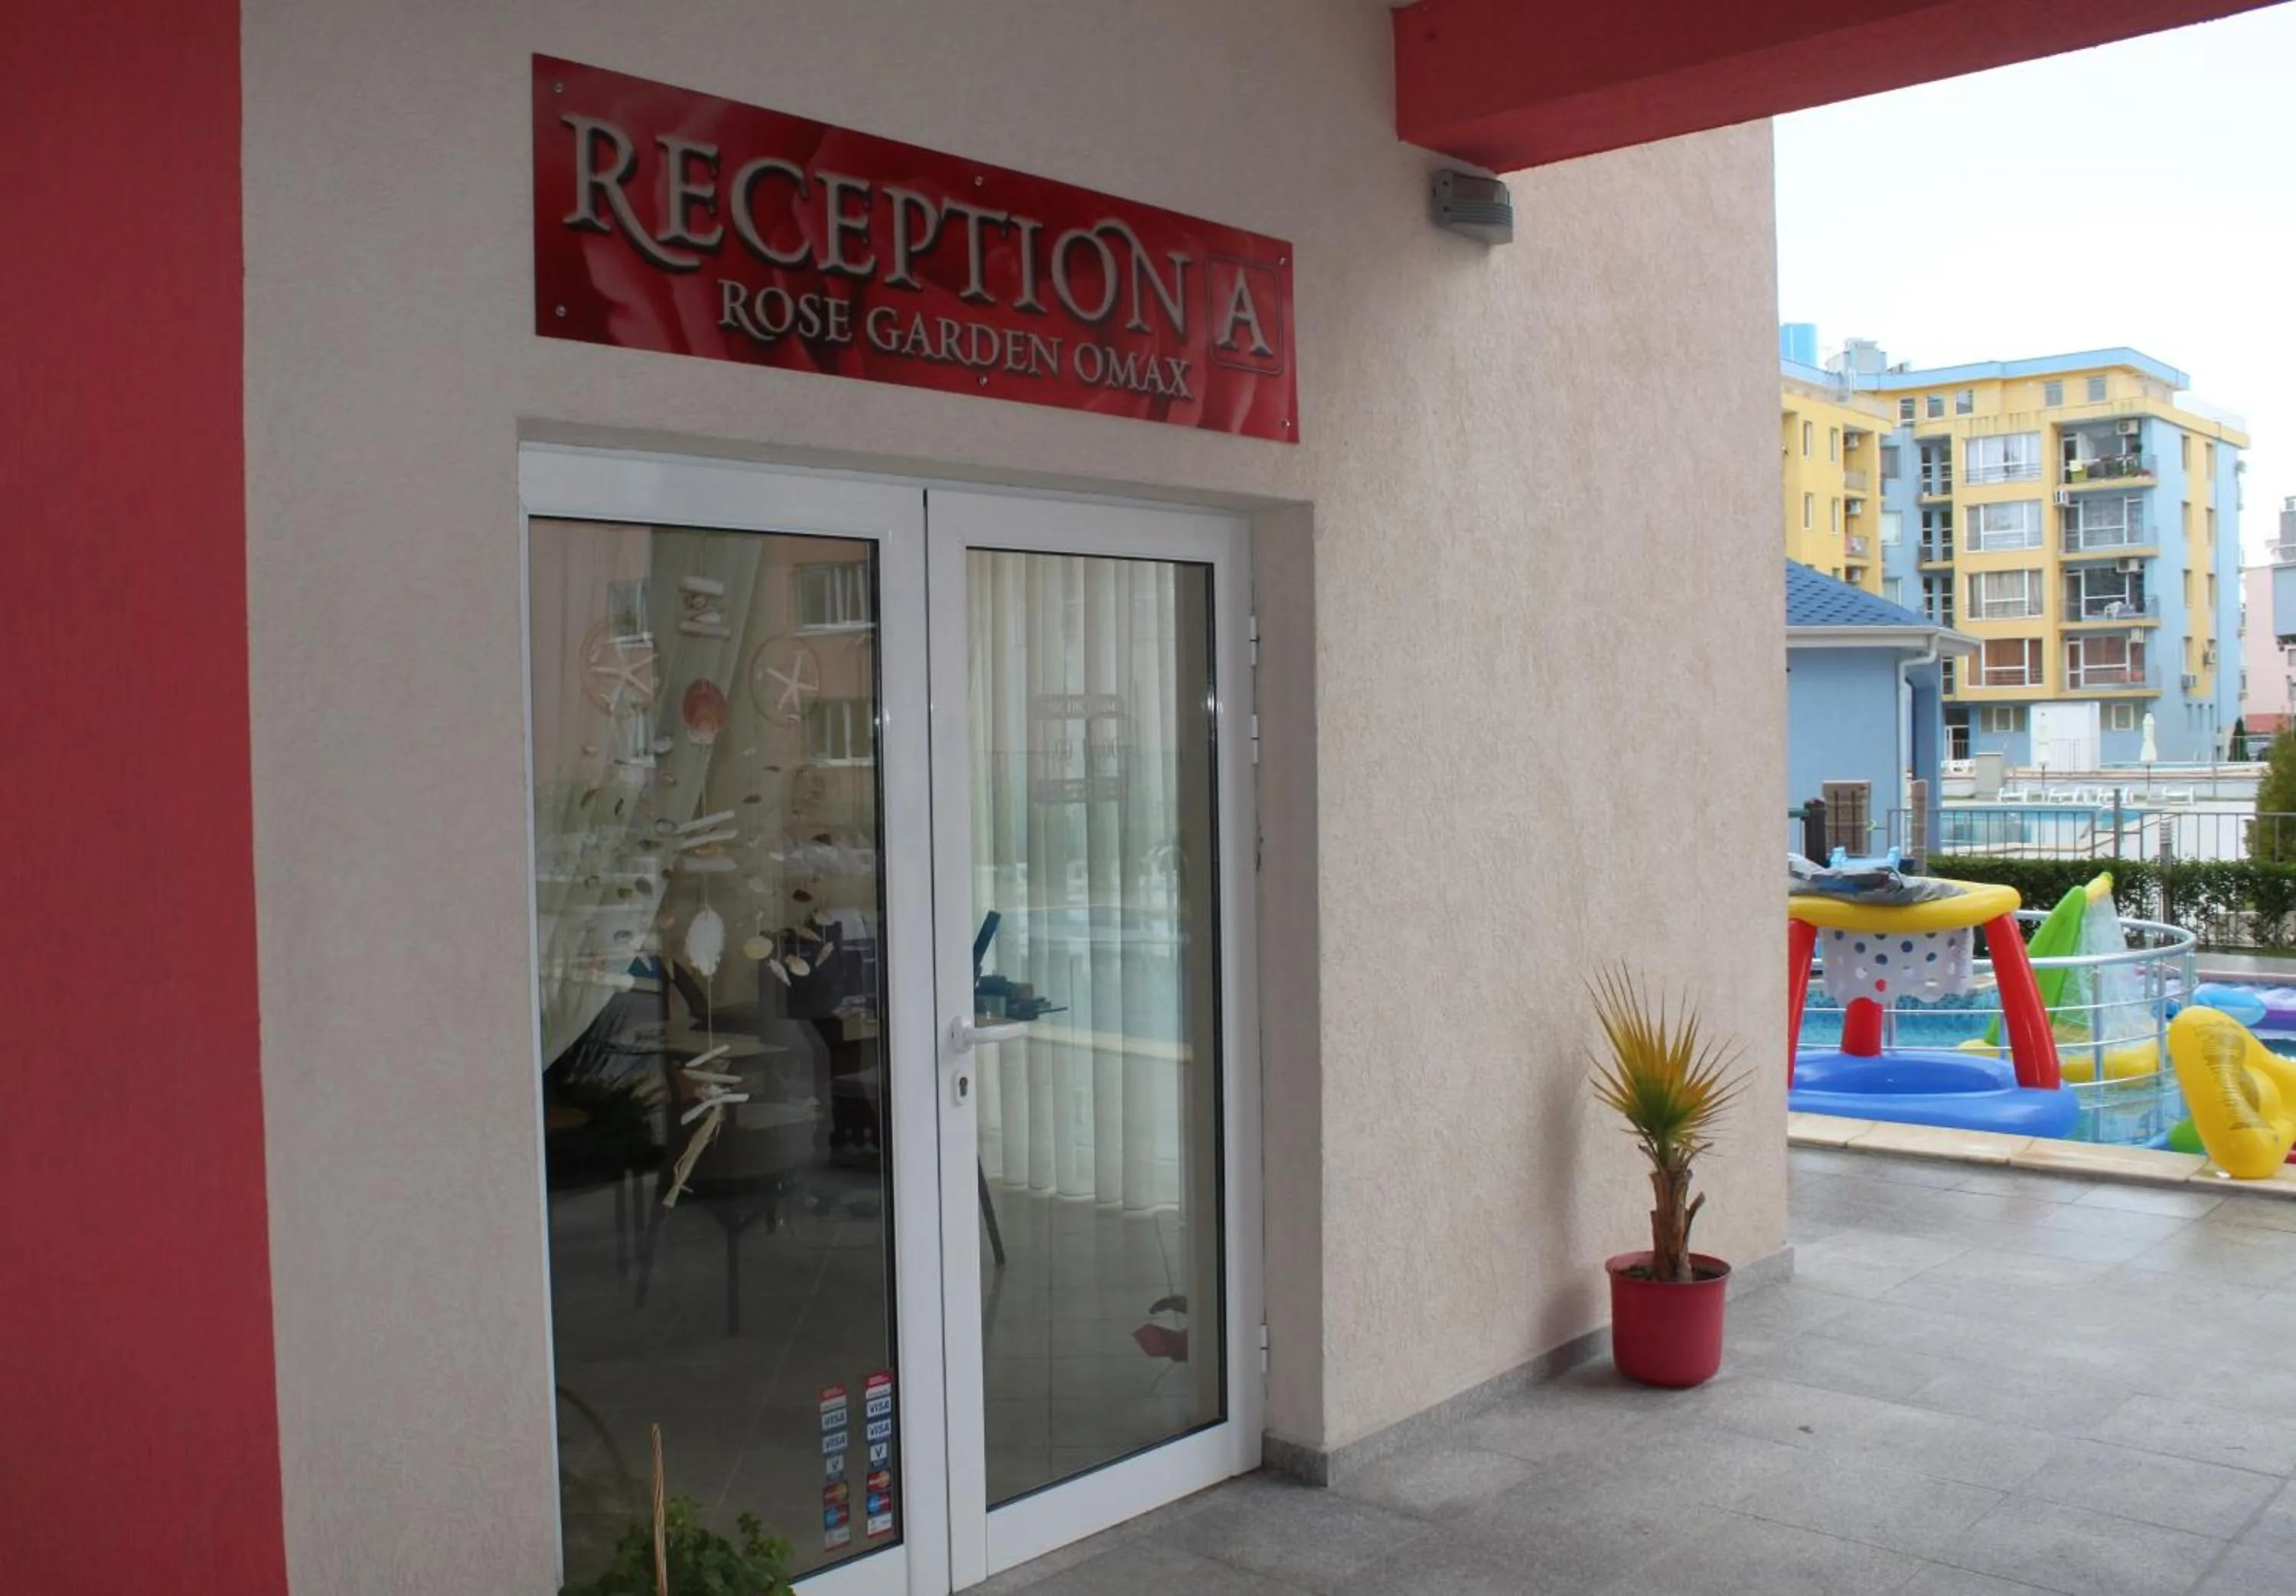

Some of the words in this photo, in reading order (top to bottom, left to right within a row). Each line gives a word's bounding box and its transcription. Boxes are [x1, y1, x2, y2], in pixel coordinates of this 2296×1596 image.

[560, 112, 1194, 342] RECEPTION
[1215, 269, 1274, 358] A
[716, 278, 853, 344] ROSE
[866, 305, 1064, 379] GARDEN
[1072, 341, 1195, 400] OMAX
